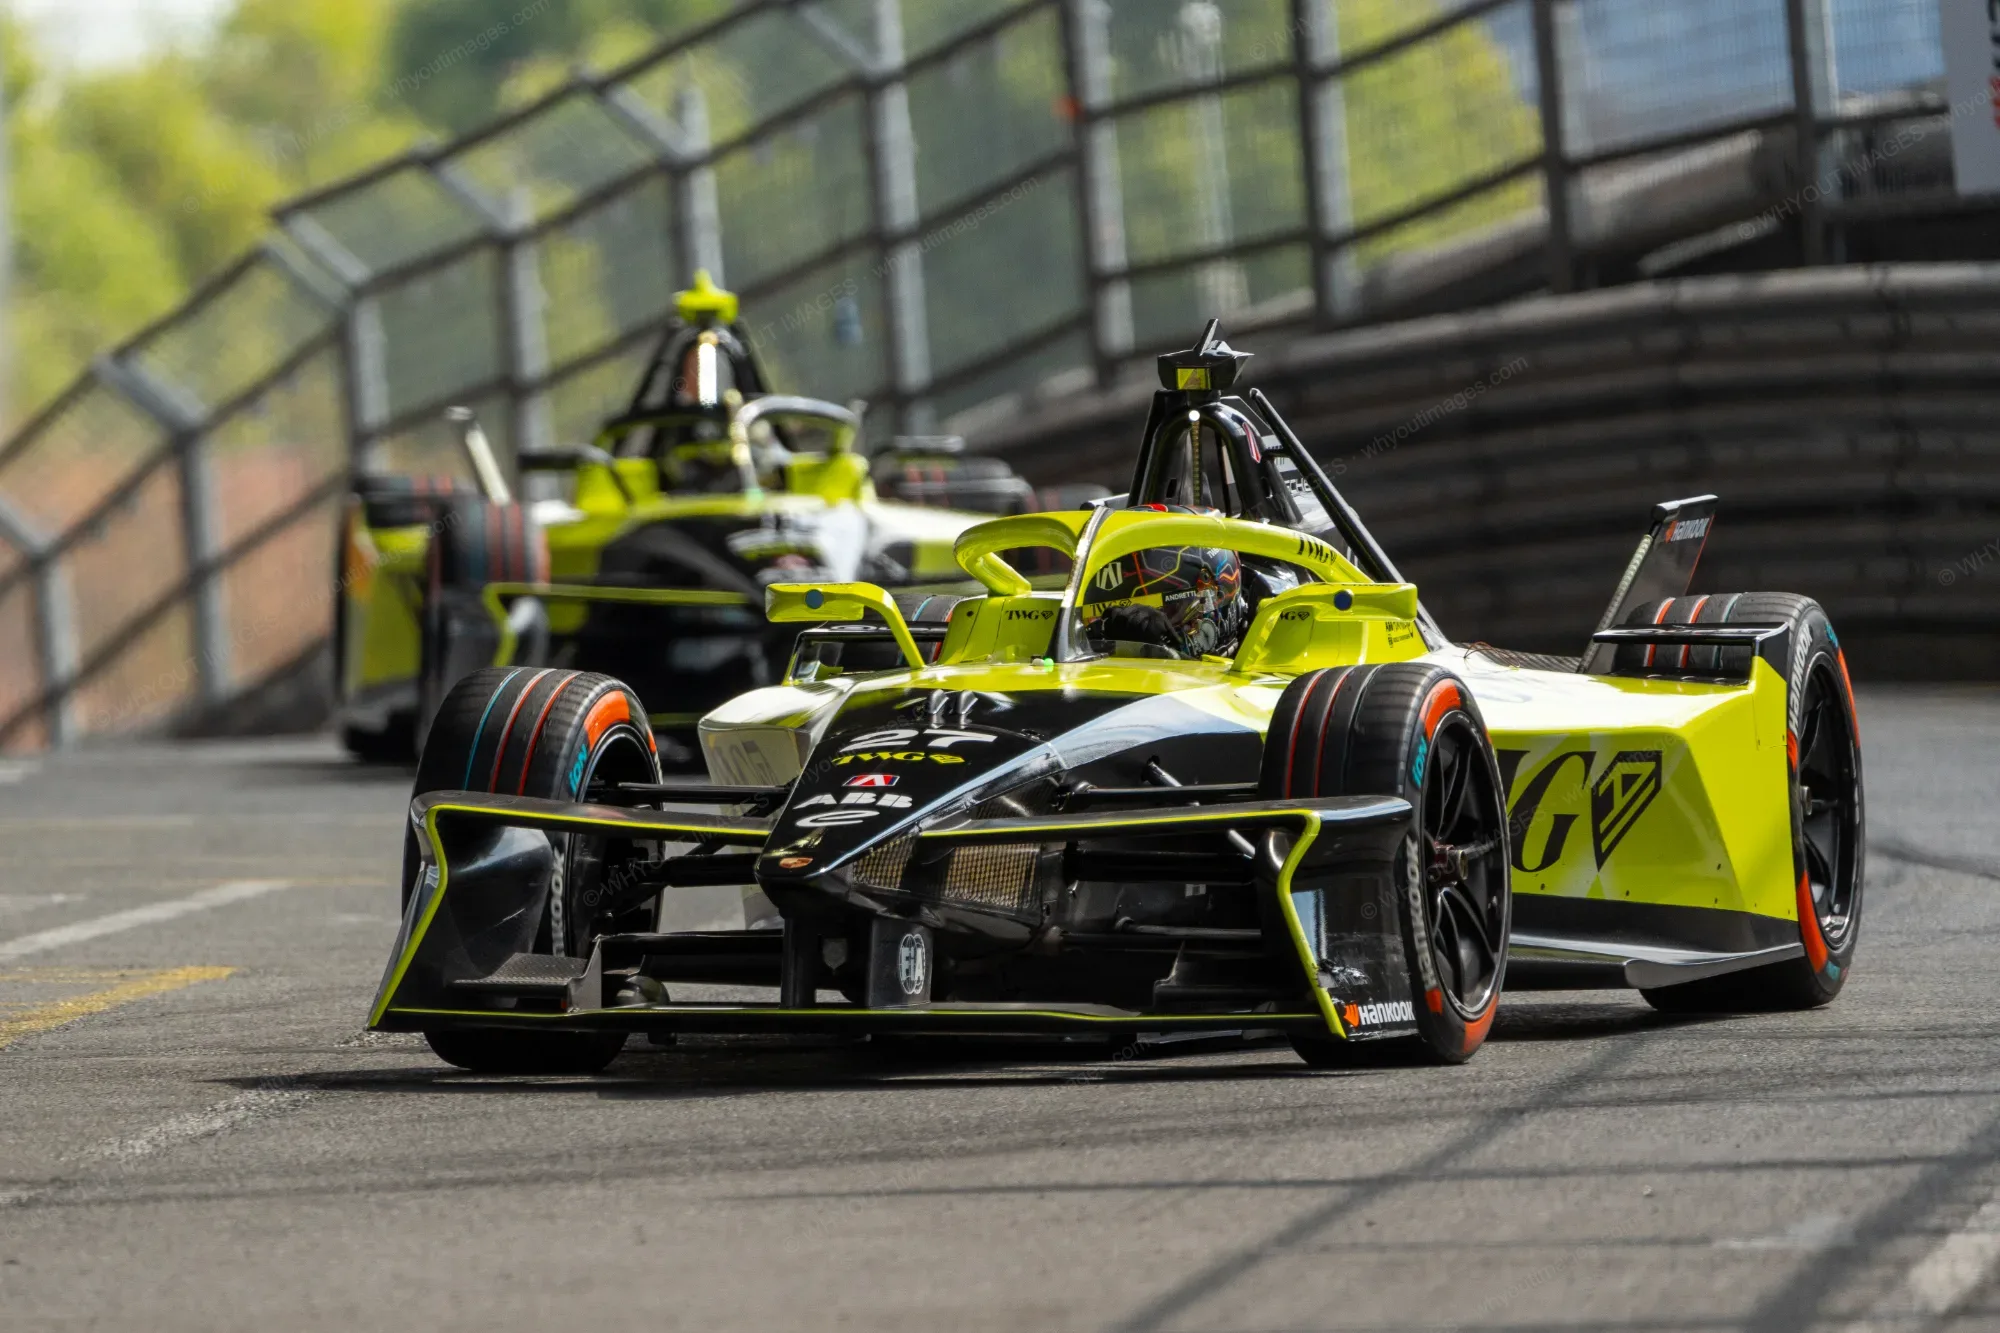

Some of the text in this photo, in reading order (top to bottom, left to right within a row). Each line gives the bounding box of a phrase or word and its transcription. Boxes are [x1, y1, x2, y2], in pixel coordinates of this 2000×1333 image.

[1005, 610, 1039, 620] TWG
[839, 729, 998, 753] 27
[831, 752, 926, 766] TWG
[793, 792, 913, 810] ABB
[902, 946, 923, 981] FIA
